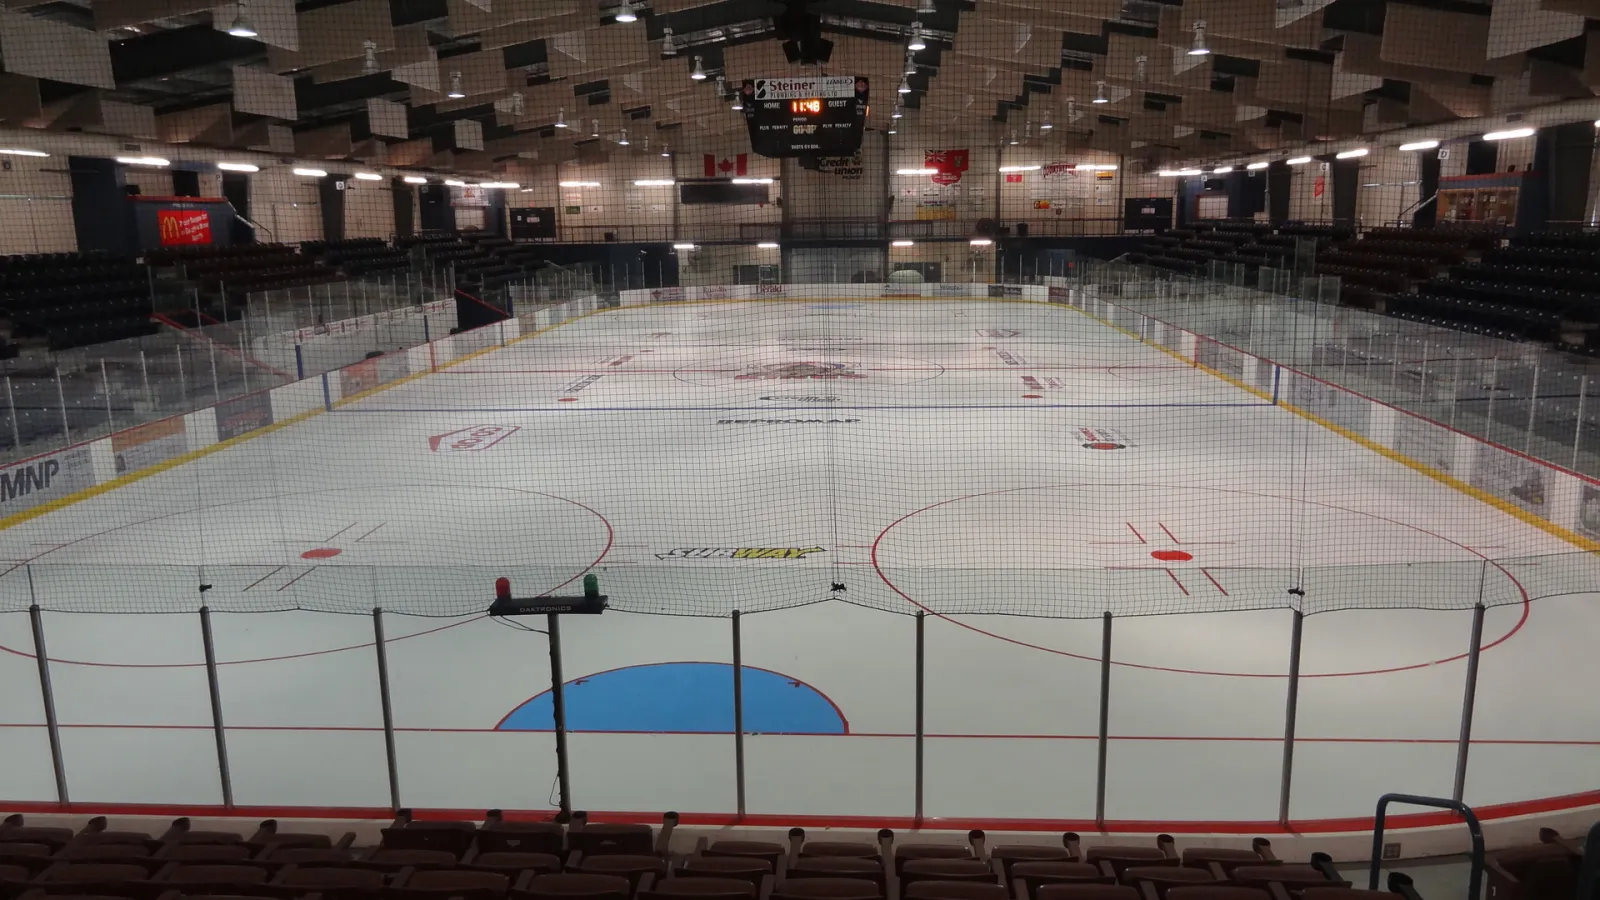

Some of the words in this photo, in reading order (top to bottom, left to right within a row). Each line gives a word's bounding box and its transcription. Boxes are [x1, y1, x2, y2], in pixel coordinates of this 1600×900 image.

[769, 79, 816, 91] Steiner
[828, 100, 847, 108] GUEST
[1440, 150, 1448, 158] D
[820, 157, 849, 167] Credit
[834, 167, 863, 175] union
[0, 459, 59, 502] MNP
[655, 545, 827, 560] SUBWAY
[519, 605, 572, 613] DAKTRONICS
